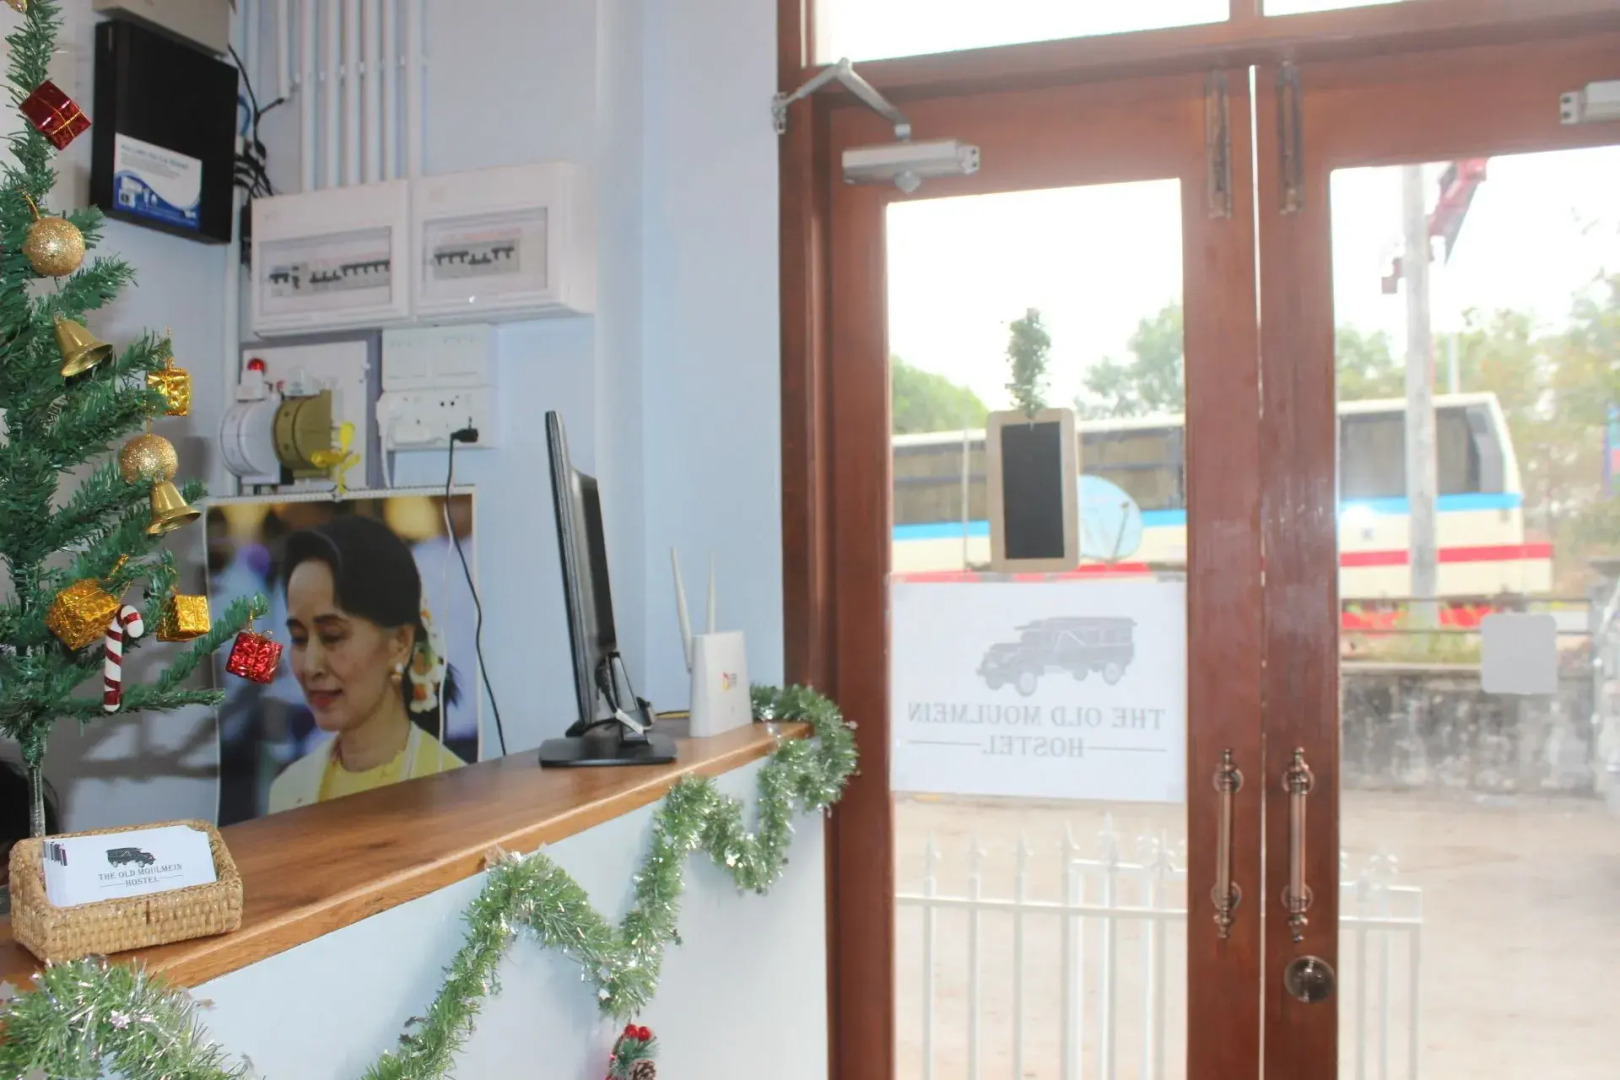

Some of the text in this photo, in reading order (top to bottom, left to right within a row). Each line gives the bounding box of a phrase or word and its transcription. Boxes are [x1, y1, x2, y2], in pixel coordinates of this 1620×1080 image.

[99, 863, 182, 881] THE OLD MOULMEIN
[125, 876, 159, 887] HOSTEL
